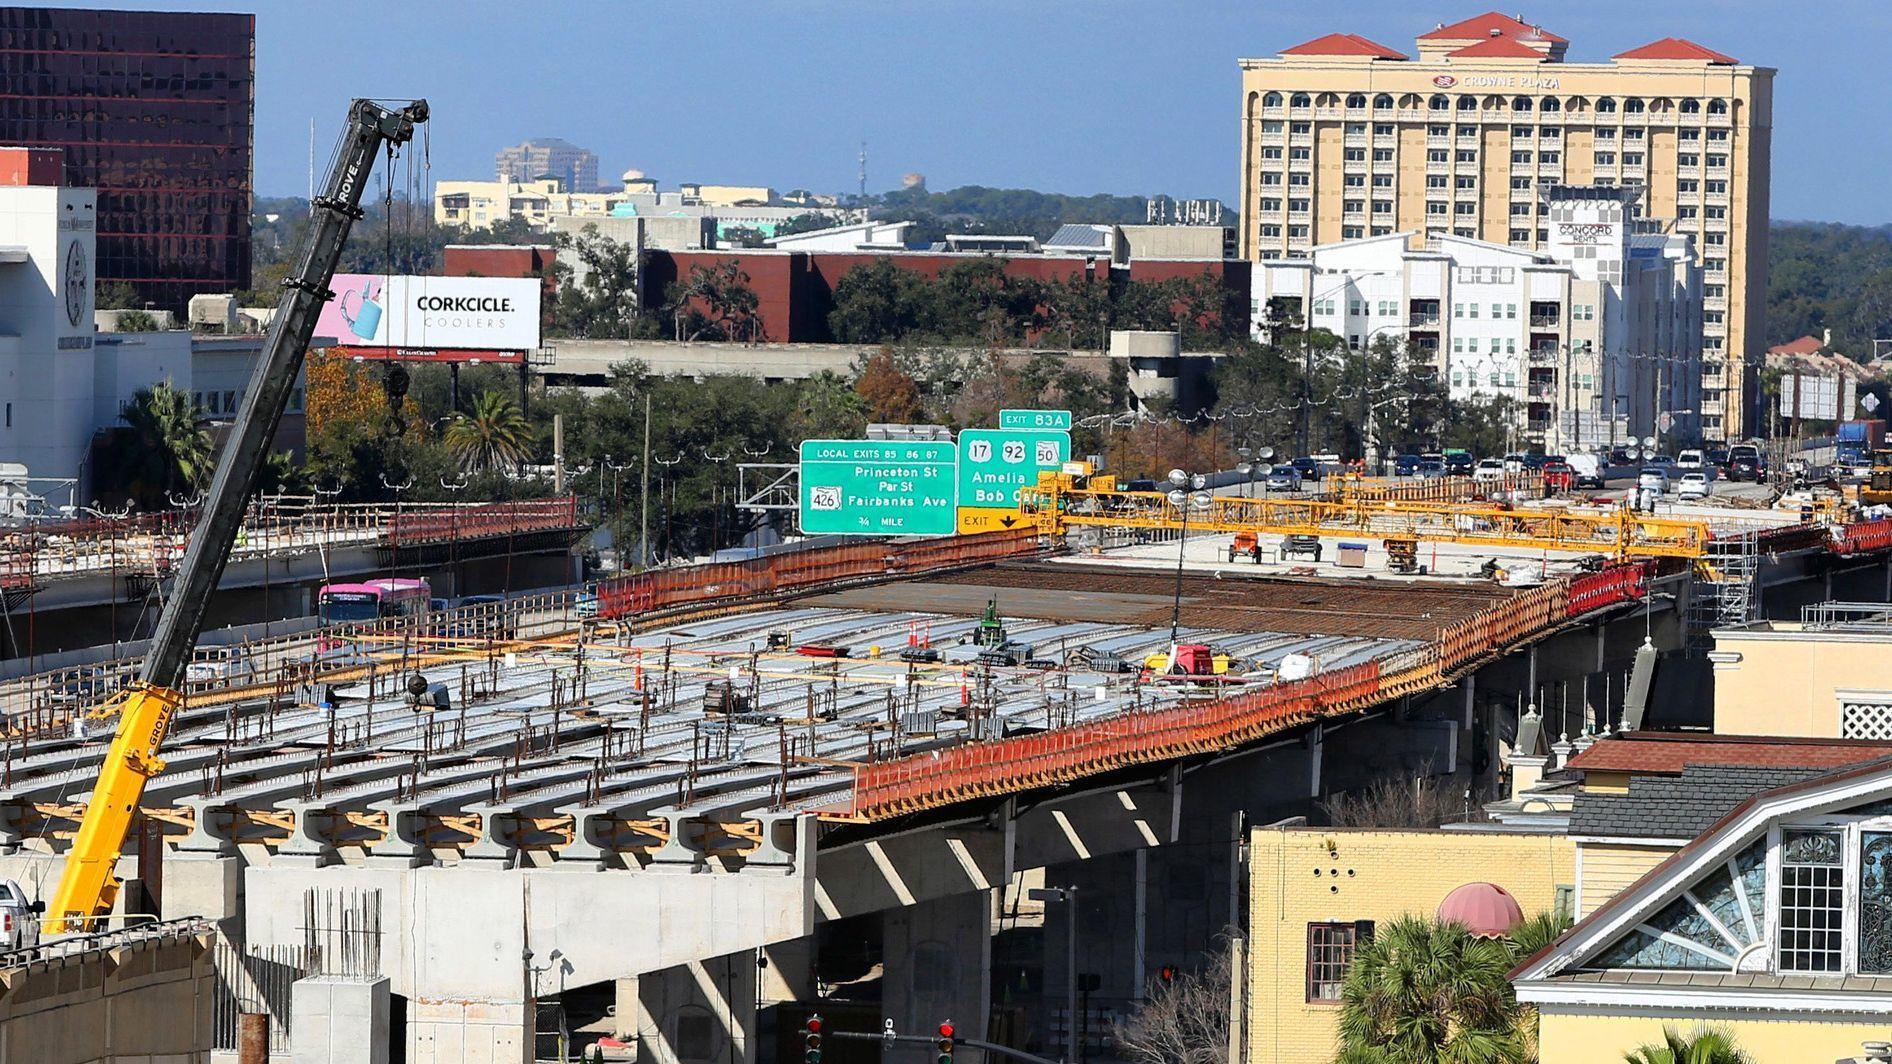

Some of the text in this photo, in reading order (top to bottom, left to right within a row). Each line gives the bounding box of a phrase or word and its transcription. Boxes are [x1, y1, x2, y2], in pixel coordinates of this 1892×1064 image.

[1463, 77, 1560, 90] CROWNE PLAZA
[337, 164, 359, 203] ROVE
[1560, 225, 1612, 235] CONCORD
[1573, 235, 1597, 243] RENTS
[424, 317, 506, 329] COOLERS
[1006, 414, 1064, 426] EXIT 83A
[817, 449, 938, 459] LOCAL EXITS 85 86 87
[973, 445, 1023, 459] 17 92
[1038, 450, 1053, 461] 50
[855, 467, 938, 478] Princeton St
[971, 471, 1026, 483] Amelia
[879, 481, 913, 492] Par St
[813, 494, 834, 507] 426
[848, 496, 948, 507] Fairbanks Ave
[975, 490, 1005, 502] Bob
[881, 517, 904, 526] MILE
[964, 516, 989, 526] EXIT
[150, 704, 169, 746] GROVE
